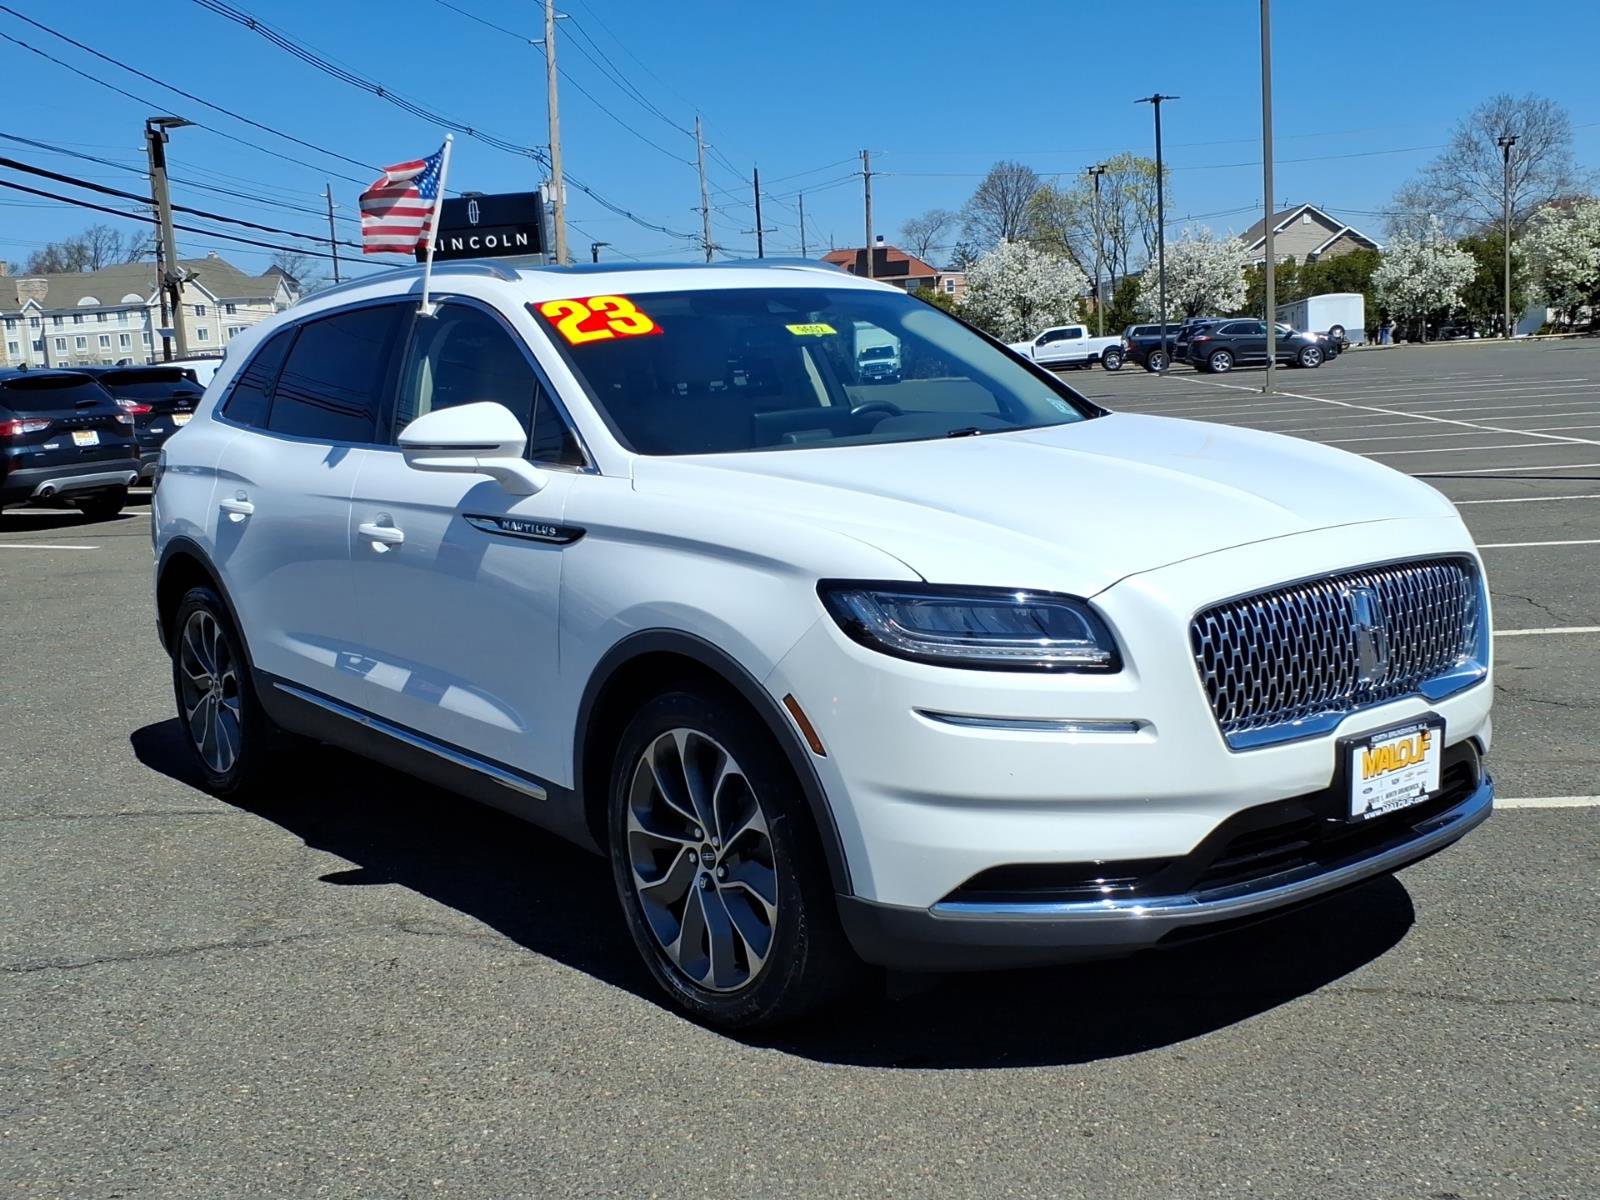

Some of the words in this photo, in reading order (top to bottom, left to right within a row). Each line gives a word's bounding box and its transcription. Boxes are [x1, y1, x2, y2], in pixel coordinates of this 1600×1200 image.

[540, 295, 655, 345] 23
[501, 520, 557, 536] NAUTILUS
[1362, 732, 1431, 780] MALOUF
